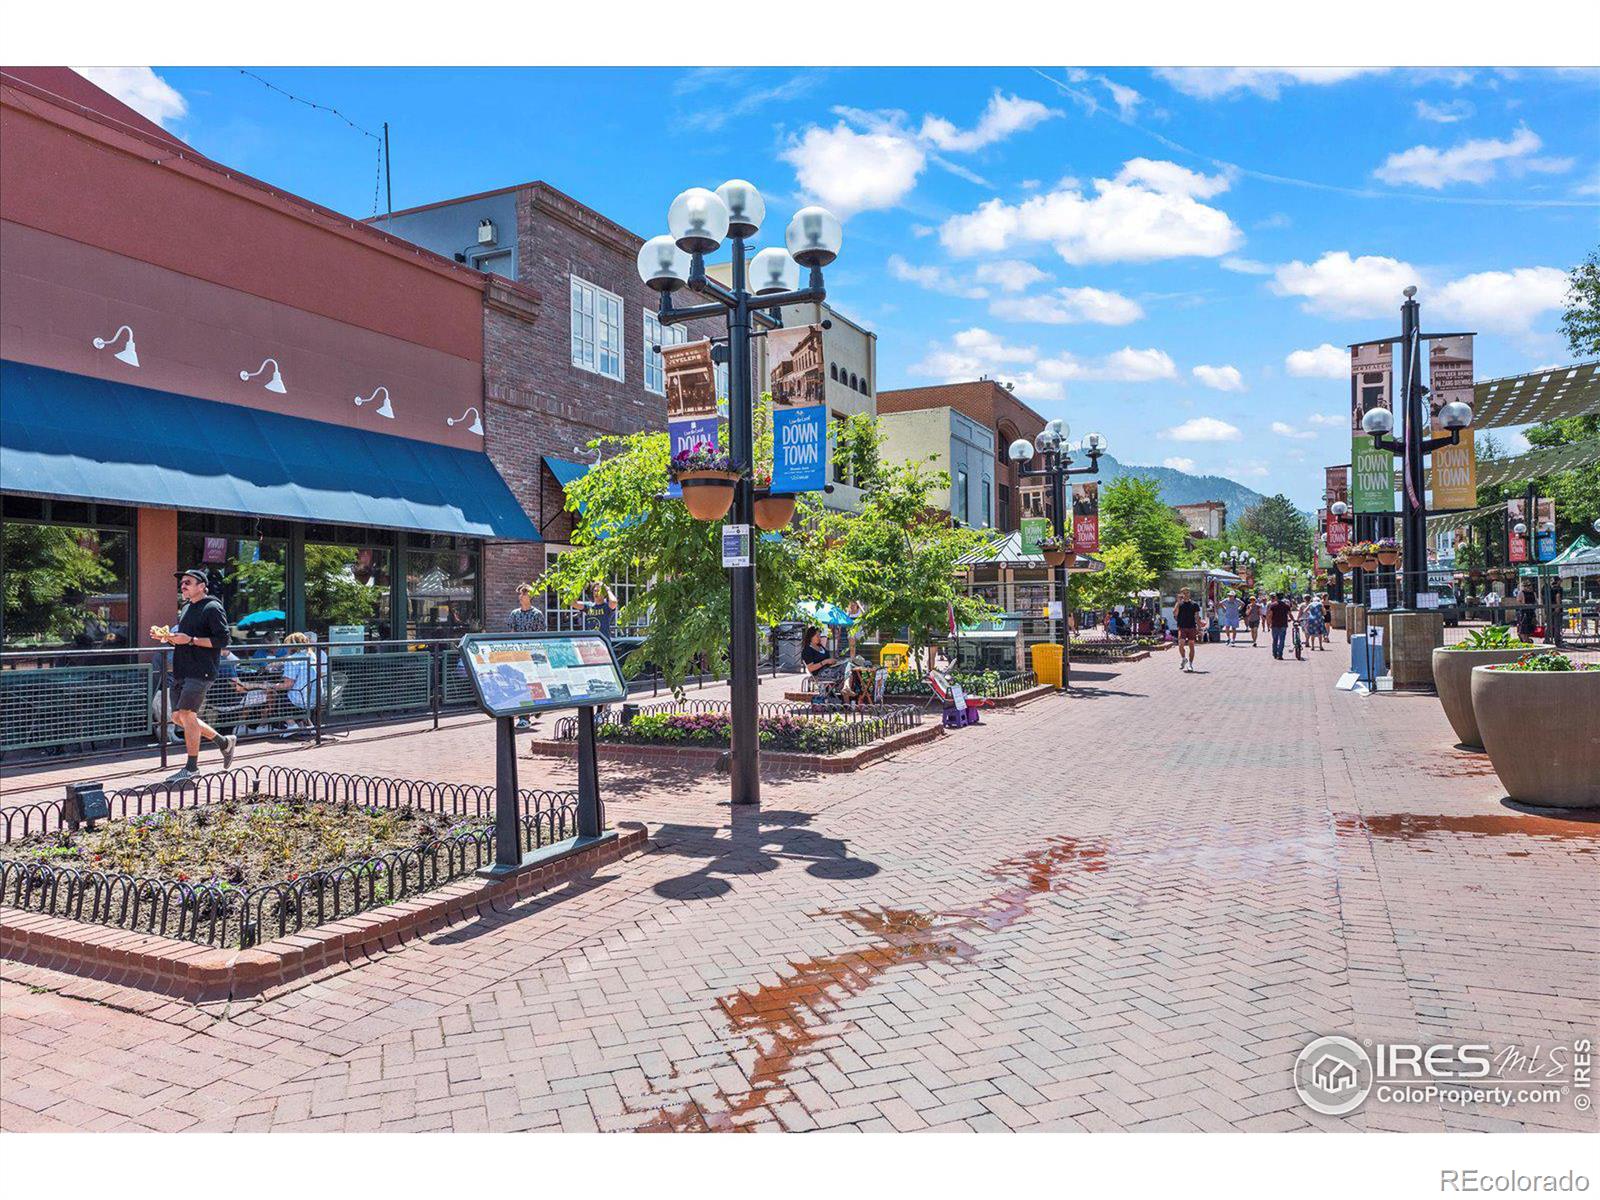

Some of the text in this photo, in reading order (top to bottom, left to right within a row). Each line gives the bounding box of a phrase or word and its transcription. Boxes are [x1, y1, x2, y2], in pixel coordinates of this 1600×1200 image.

[782, 422, 818, 446] DOWN
[783, 443, 818, 466] TOWN
[1357, 454, 1389, 473] DOWN
[1436, 448, 1470, 468] DOWN
[1357, 472, 1389, 491] TOWN
[1437, 466, 1471, 488] TOWN
[1077, 522, 1096, 532] DOWN
[1329, 523, 1346, 533] DOWN
[1078, 532, 1096, 542] TOWN
[1329, 533, 1346, 543] TOWN
